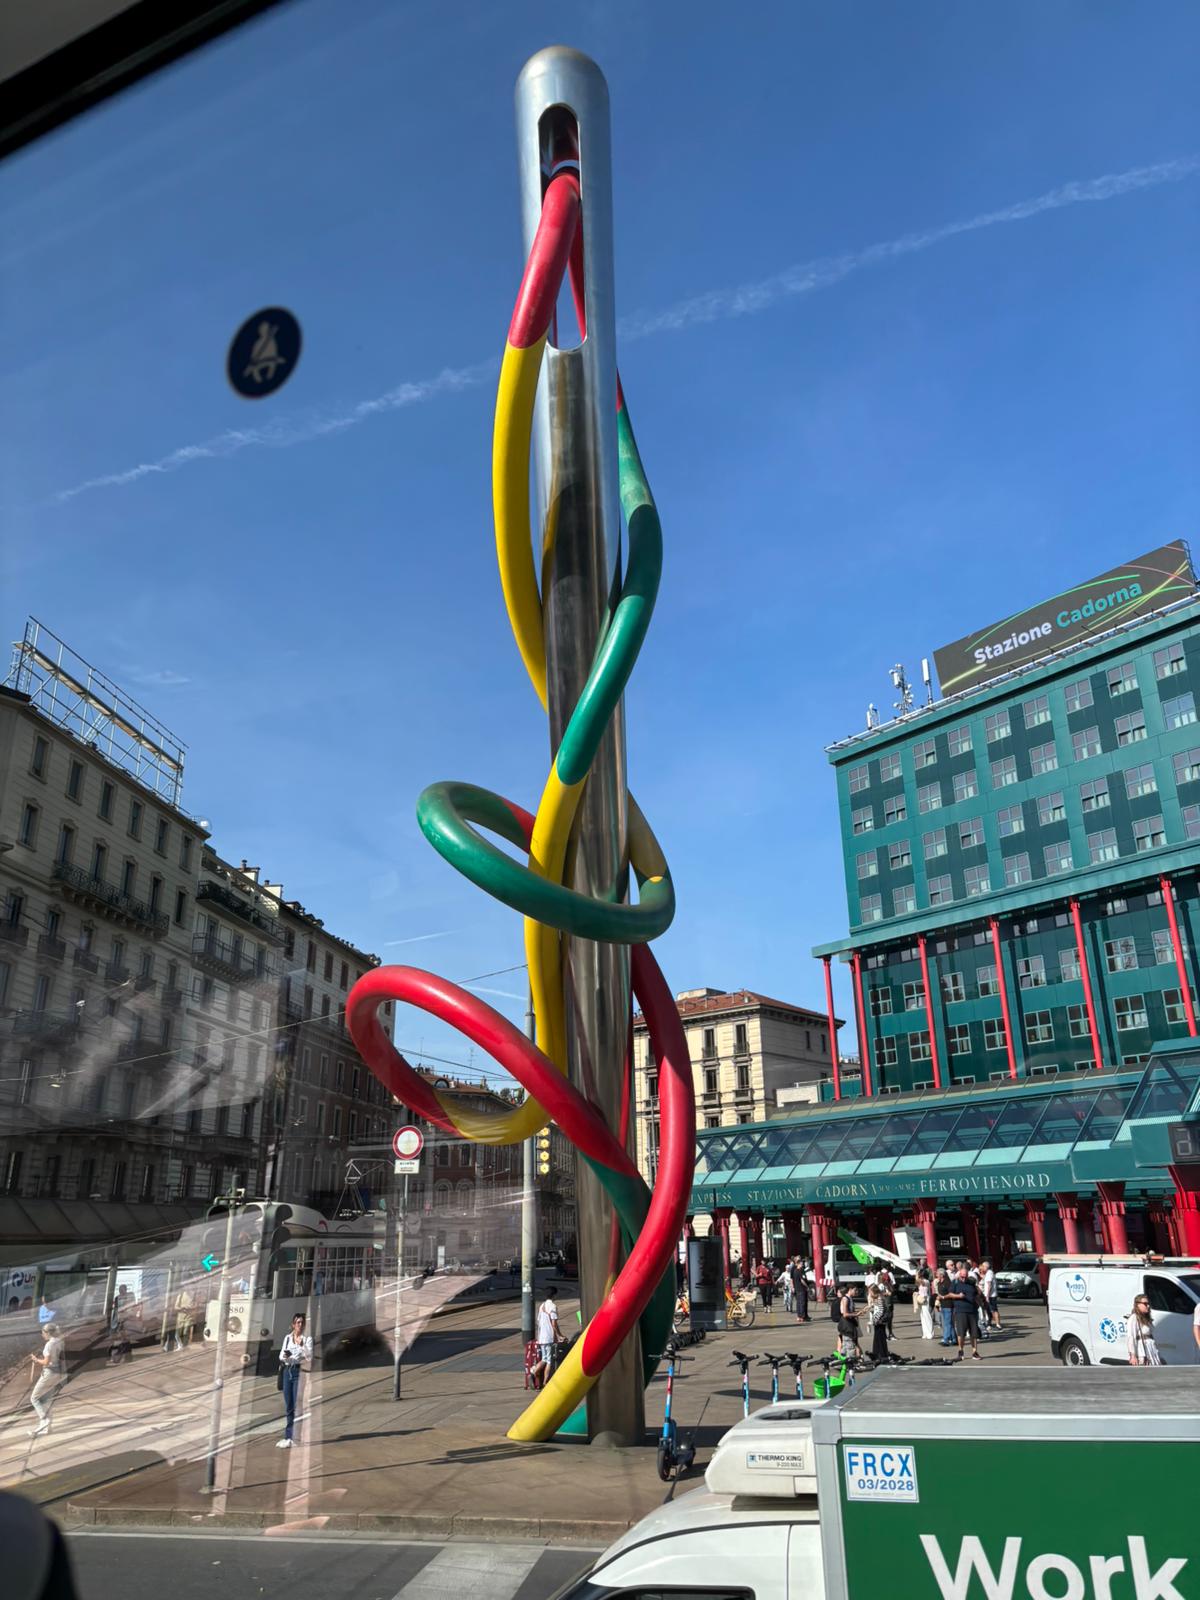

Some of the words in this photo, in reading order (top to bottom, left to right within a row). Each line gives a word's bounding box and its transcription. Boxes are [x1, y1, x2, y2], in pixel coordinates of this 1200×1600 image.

[974, 622, 1052, 664] Stazione
[1056, 582, 1143, 628] Cadorna
[747, 1187, 802, 1201] STAZIONE
[815, 1182, 877, 1198] CADORNA
[920, 1173, 1050, 1193] FERROVIENORD
[848, 1452, 912, 1477] FRCX
[858, 1478, 914, 1491] 03/2028
[919, 1534, 1189, 1600] Work
